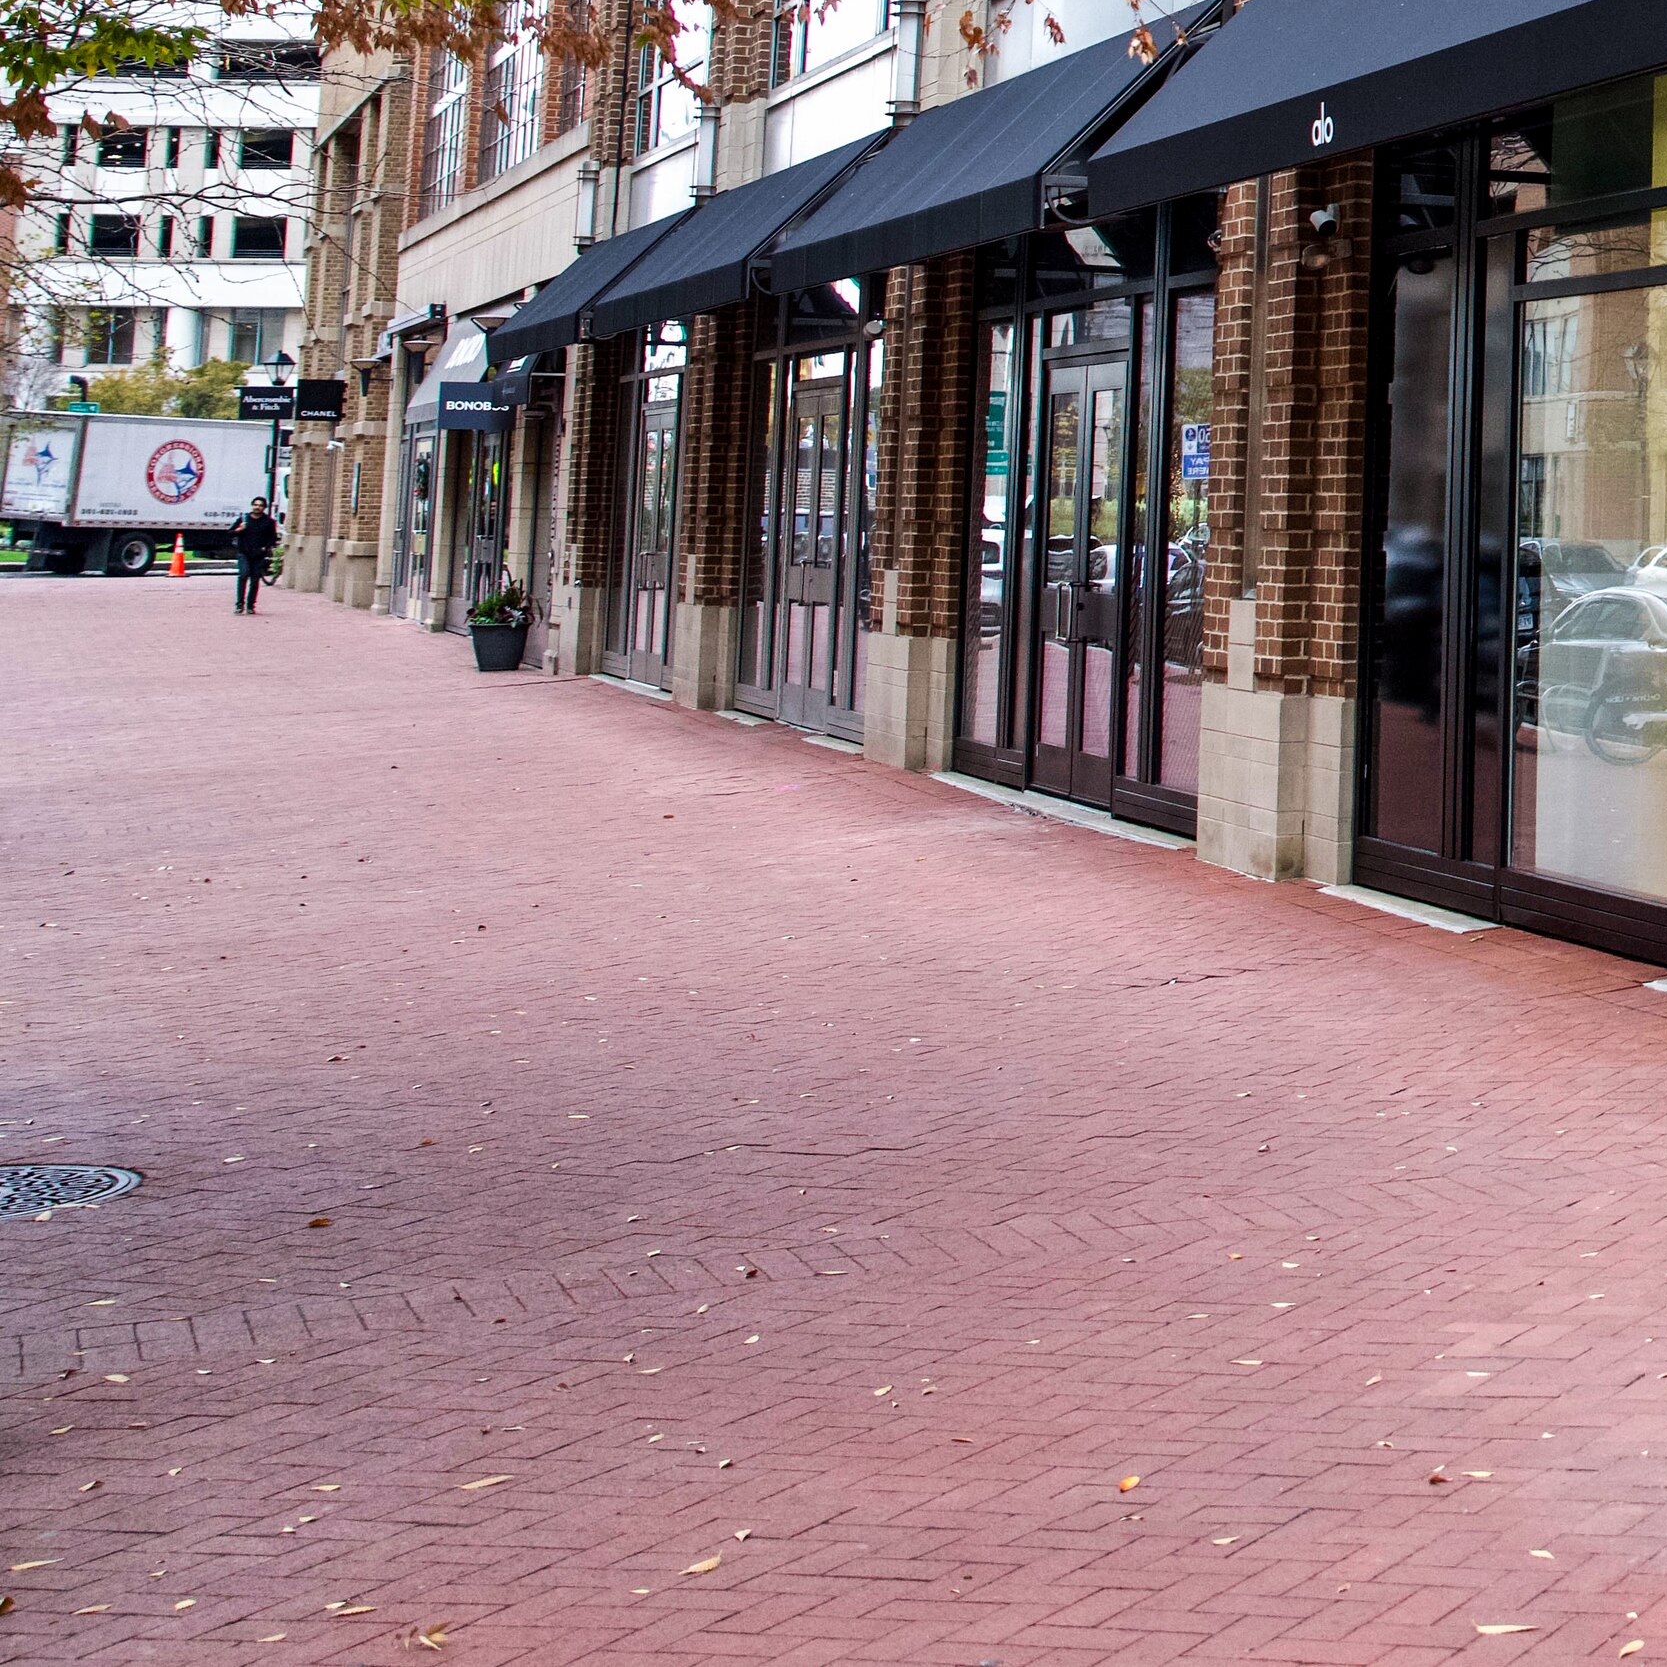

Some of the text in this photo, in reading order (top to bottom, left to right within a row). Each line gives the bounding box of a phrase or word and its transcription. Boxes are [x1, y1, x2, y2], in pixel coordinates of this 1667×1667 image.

[1312, 102, 1334, 146] alo
[242, 395, 292, 403] Abercrombie
[260, 402, 280, 411] Fitch
